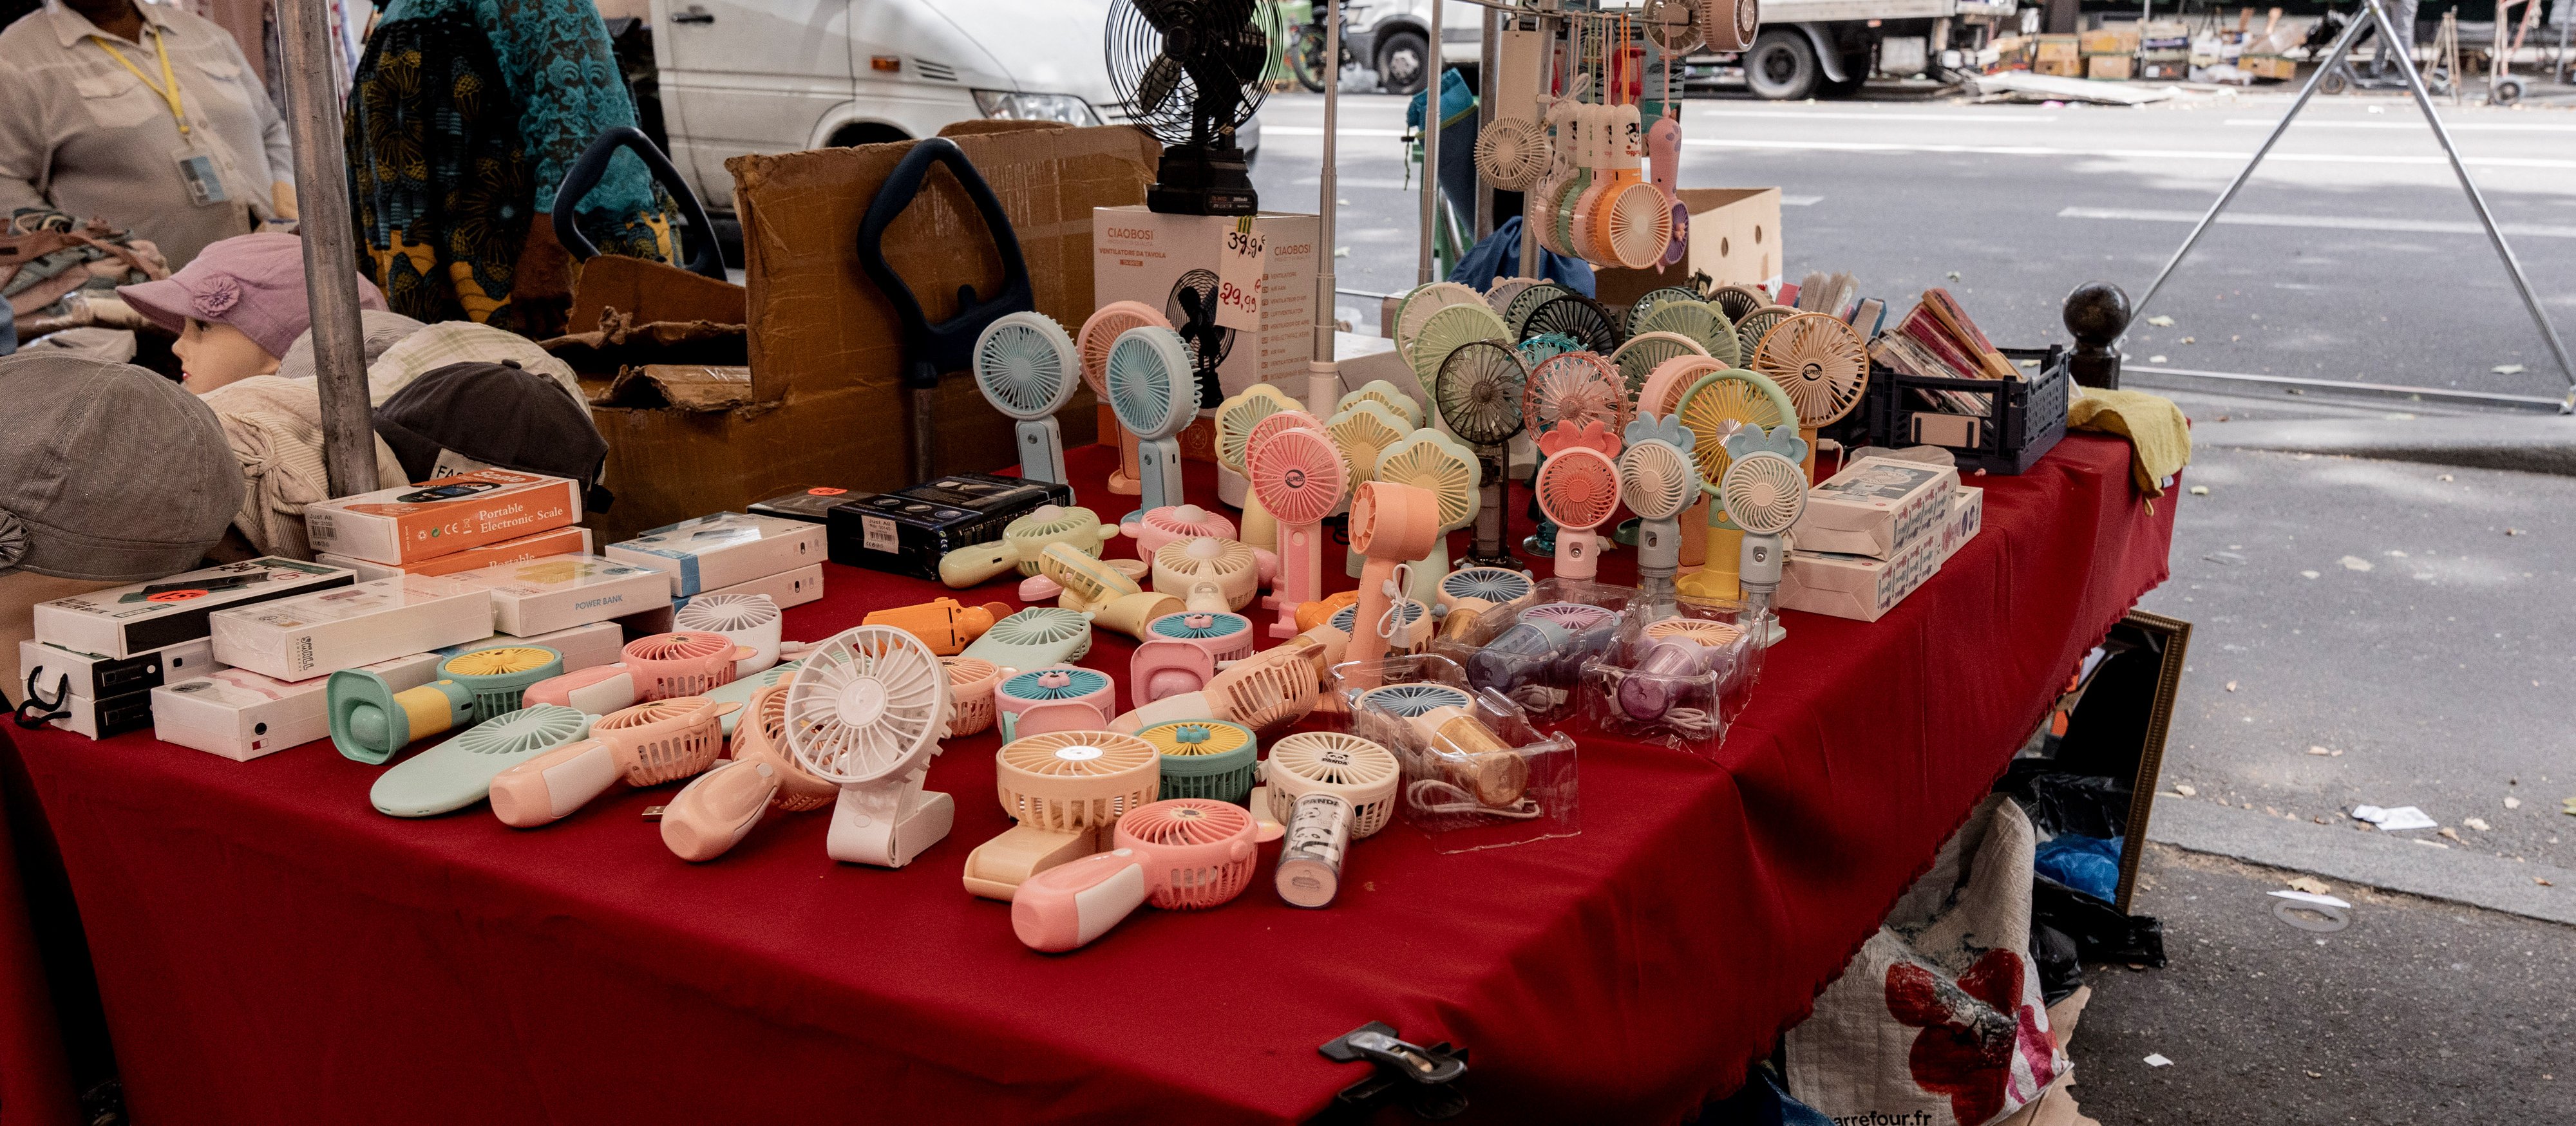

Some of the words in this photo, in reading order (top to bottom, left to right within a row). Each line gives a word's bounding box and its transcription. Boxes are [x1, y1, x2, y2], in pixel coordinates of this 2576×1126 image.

[1108, 227, 1153, 240] CIAOBOSI
[1099, 247, 1135, 256] VENTILATORE
[1274, 243, 1311, 256] CIAOBOSI
[473, 471, 526, 482] Scale
[479, 503, 524, 521] Portable
[480, 514, 534, 534] Electronic
[537, 507, 564, 520] Scale
[575, 597, 601, 611] POWER
[602, 594, 623, 606] BANK
[301, 635, 314, 671] SMALL
[1321, 757, 1349, 766] PANDA
[1834, 1109, 1932, 1126] arrefour.fr
